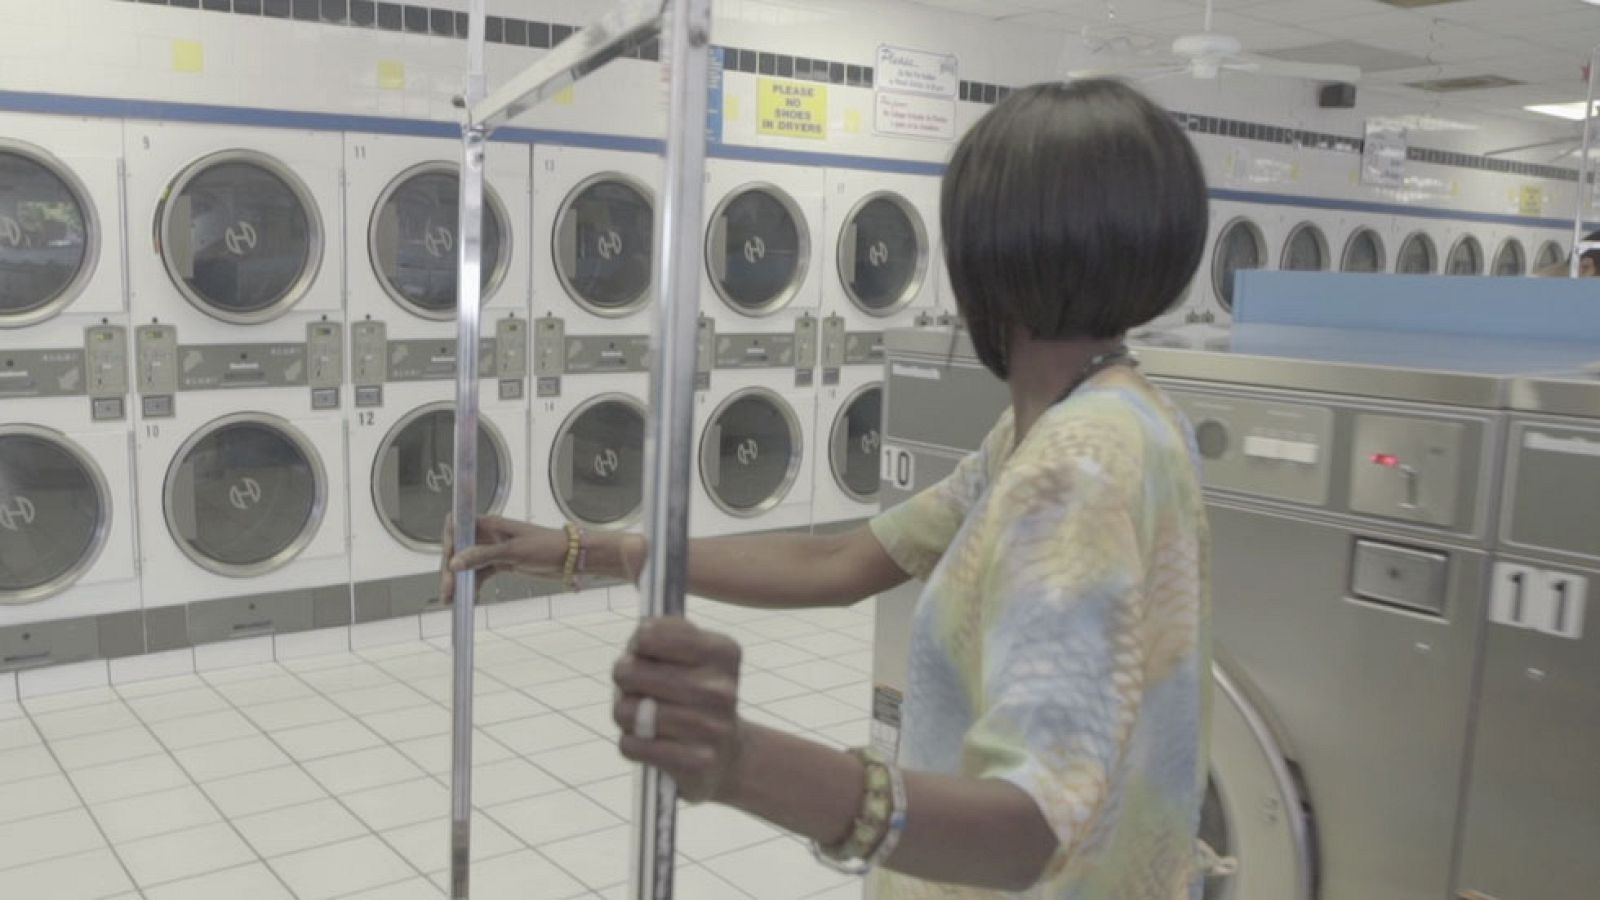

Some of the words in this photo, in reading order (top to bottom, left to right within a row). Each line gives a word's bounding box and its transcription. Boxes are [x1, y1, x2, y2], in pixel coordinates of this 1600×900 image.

[772, 85, 814, 97] PLEASE
[785, 98, 801, 107] NO
[775, 108, 811, 120] SHOES
[762, 120, 774, 129] IN
[779, 121, 822, 133] DRYERS
[354, 145, 366, 159] 11
[358, 411, 375, 426] 12
[145, 425, 159, 438] 10
[885, 448, 911, 486] 10
[1508, 572, 1568, 633] 11
